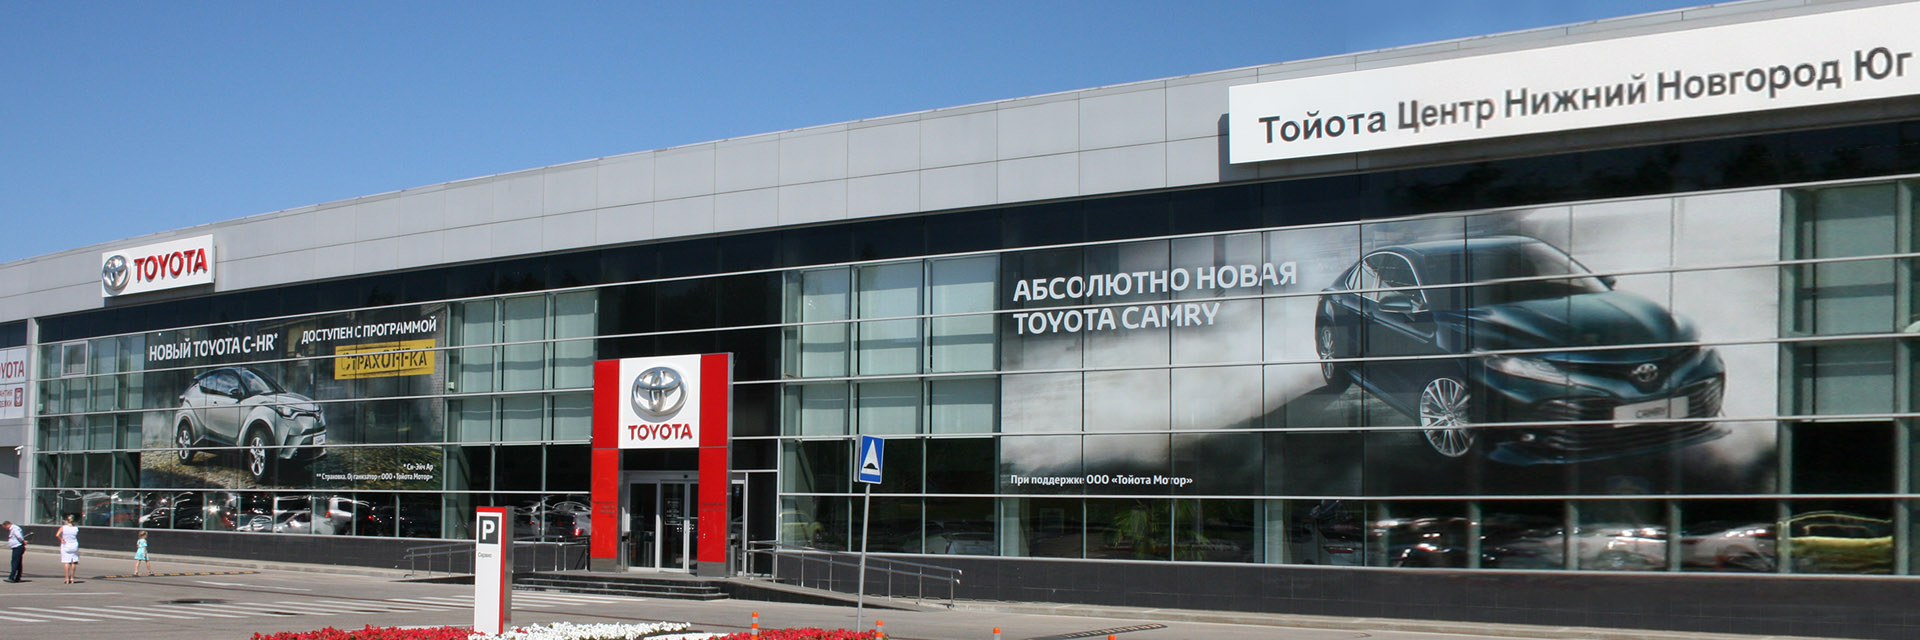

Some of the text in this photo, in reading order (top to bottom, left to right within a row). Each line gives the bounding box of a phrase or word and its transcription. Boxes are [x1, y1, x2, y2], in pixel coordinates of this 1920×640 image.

[1258, 46, 1913, 144] Тойота Центр Нижний Новгород Юг
[134, 248, 208, 282] TOYOTA
[1013, 261, 1298, 302] АБСОЛЮТНО НОВАЯ
[301, 315, 437, 345] ДОСТУПЕН С ПРОГРАММОЙ
[1013, 302, 1221, 335] TOYOTA CAMRY
[149, 337, 192, 362] НОВЫЙ
[193, 337, 241, 358] TOYOTA
[0, 360, 25, 379] YOTA
[628, 423, 693, 440] TOYOTA
[1011, 474, 1029, 486] При
[1086, 474, 1109, 485] ООО
[1111, 474, 1150, 485] «Тойота
[482, 519, 496, 540] P
